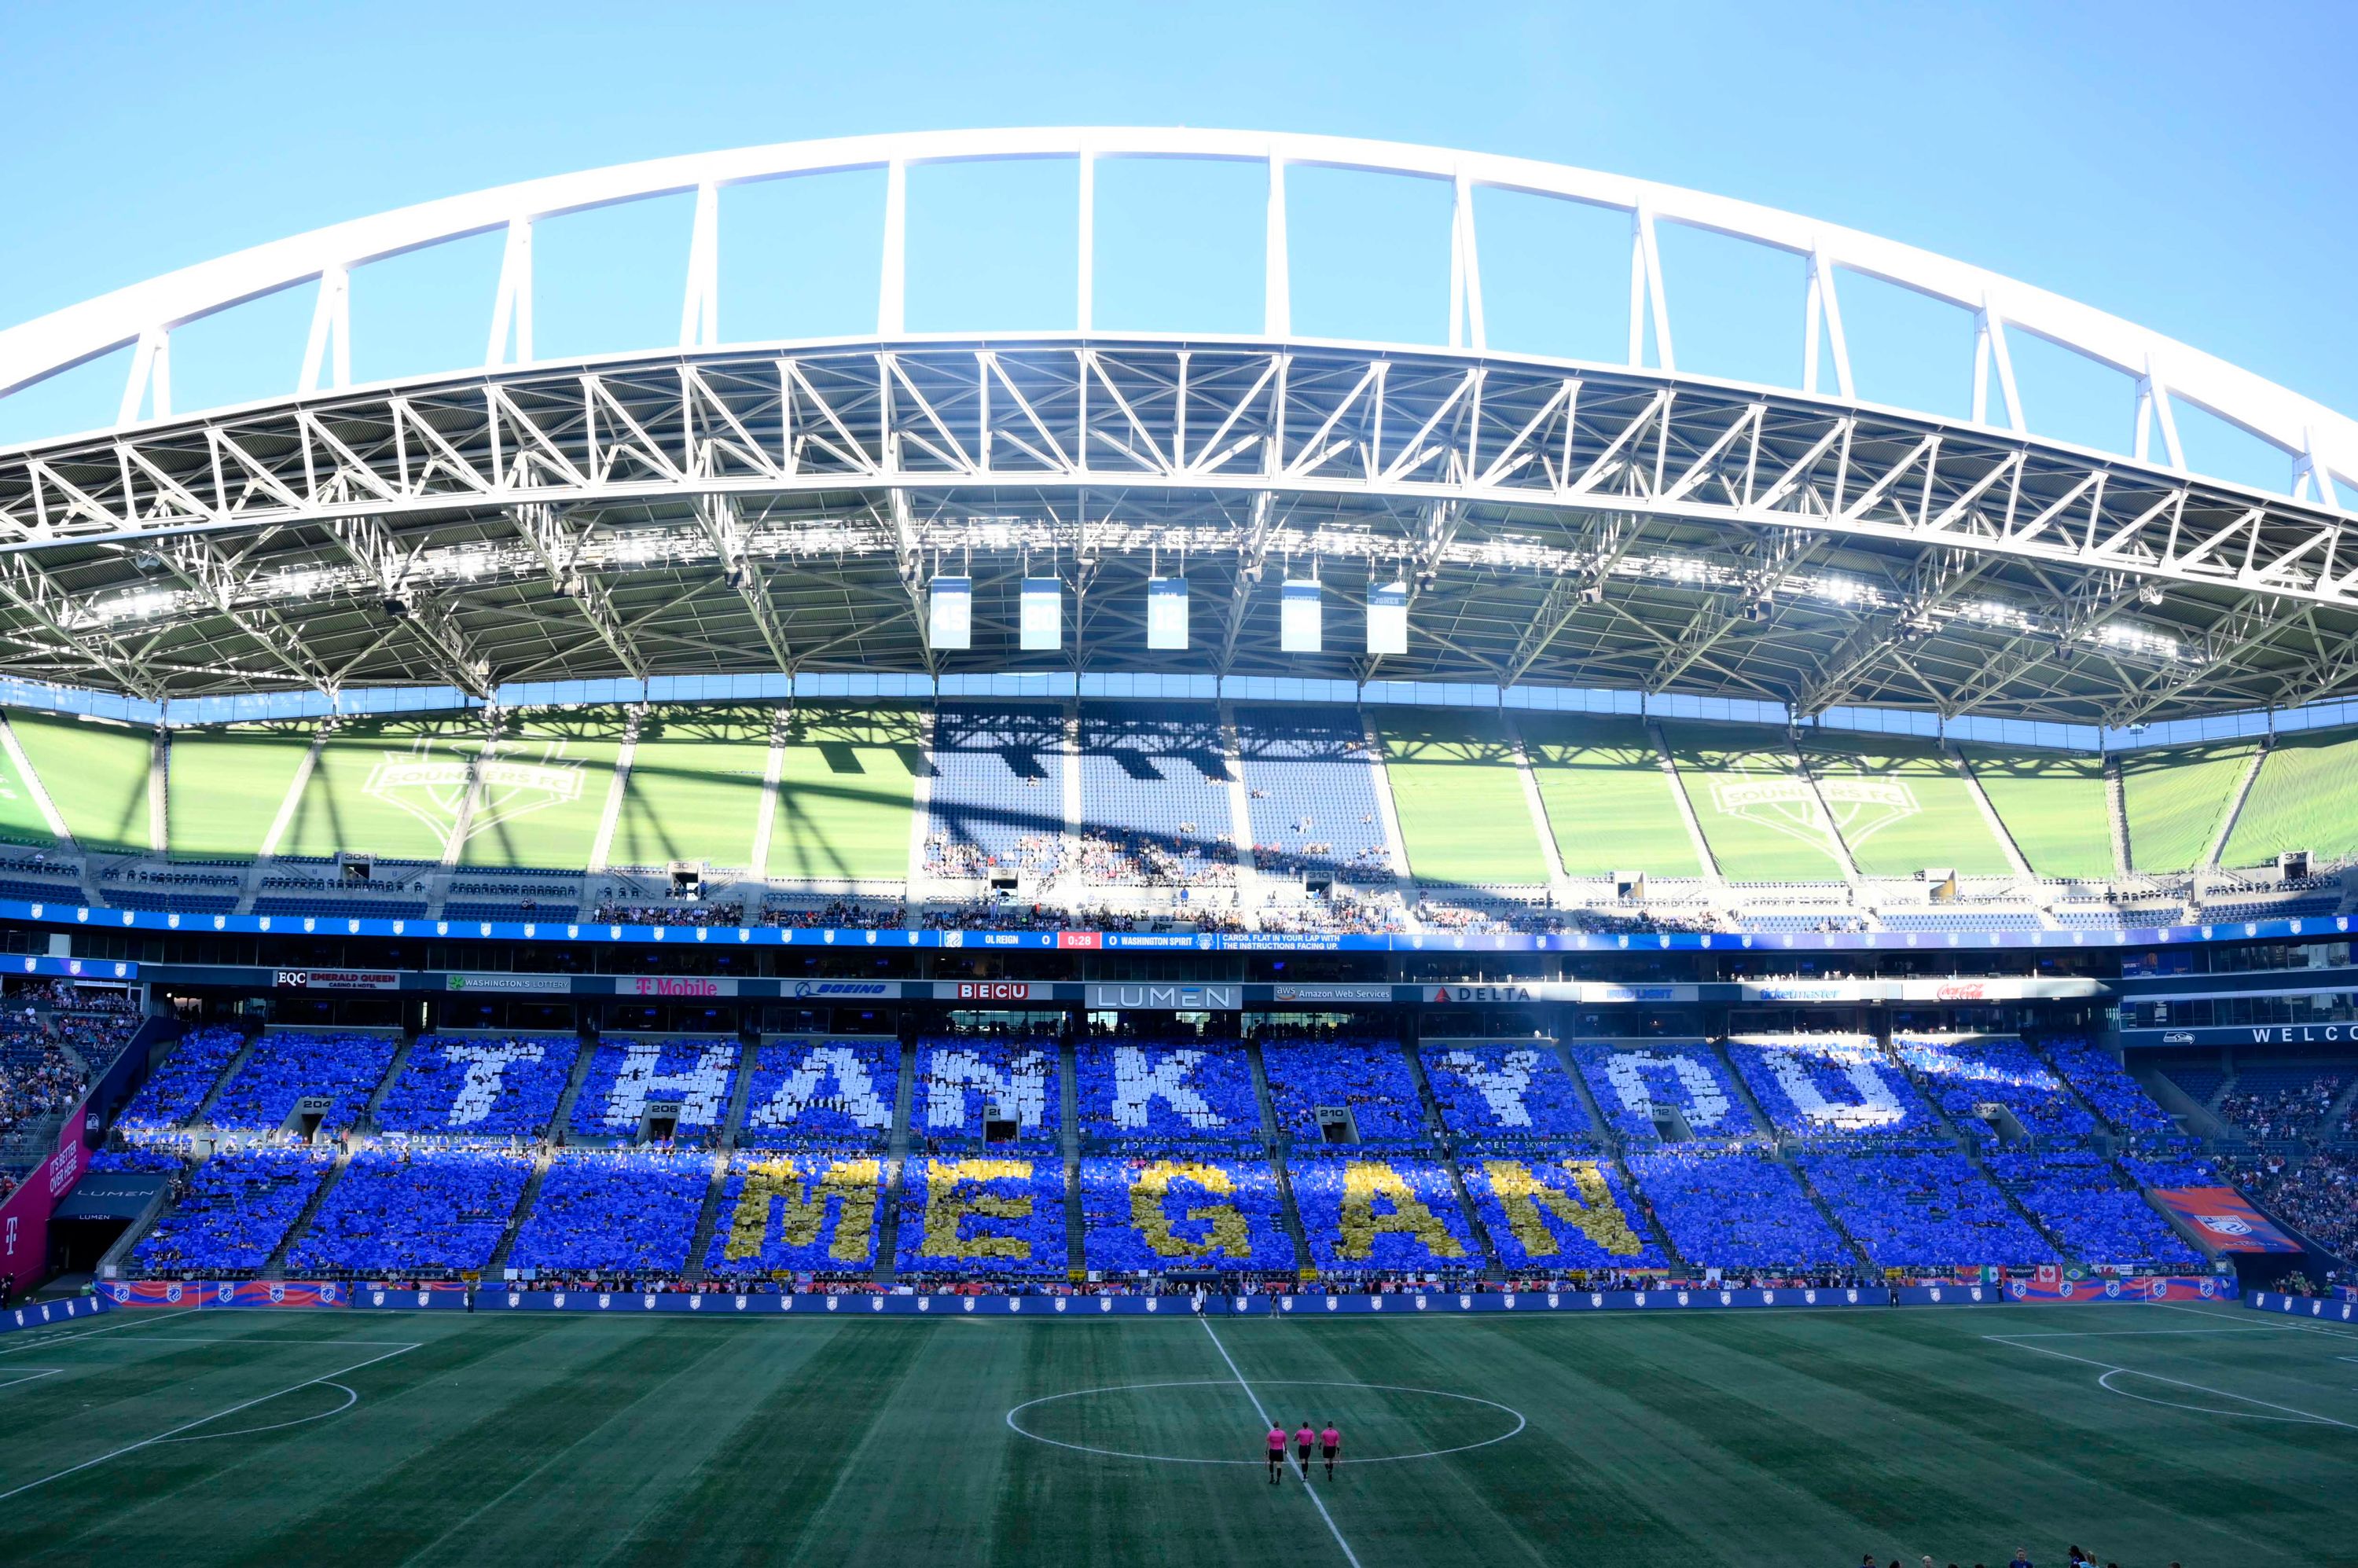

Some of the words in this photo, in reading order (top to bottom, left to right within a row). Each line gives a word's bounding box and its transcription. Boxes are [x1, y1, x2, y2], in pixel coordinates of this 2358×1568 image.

[934, 604, 967, 631] 45
[985, 935, 994, 944] OL
[996, 935, 1019, 944] REIGN
[1067, 935, 1092, 946] 0:28
[1121, 937, 1168, 946] WASHINGTON
[1170, 937, 1192, 946] SPIRIT
[277, 972, 306, 986] EQC
[310, 973, 358, 982] EMERALD
[361, 974, 395, 982] QUEEN
[817, 984, 887, 993] BOEING
[960, 984, 1027, 999] BECU
[1299, 990, 1332, 998] Amazon
[1335, 990, 1353, 998] Web
[1356, 990, 1390, 998] Services
[1458, 987, 1531, 1001] DELTA
[1759, 987, 1841, 1001] ticketmaster
[1097, 986, 1230, 1008] LUMEN
[442, 1042, 1226, 1129] THANK
[1442, 1046, 1908, 1130] YOU
[50, 1157, 59, 1176] IT'S
[59, 1140, 77, 1167] BETTER
[50, 1169, 64, 1193] OVER
[64, 1155, 77, 1179] HERE
[723, 1159, 1644, 1259] MEGAN
[6, 1217, 18, 1255] T
